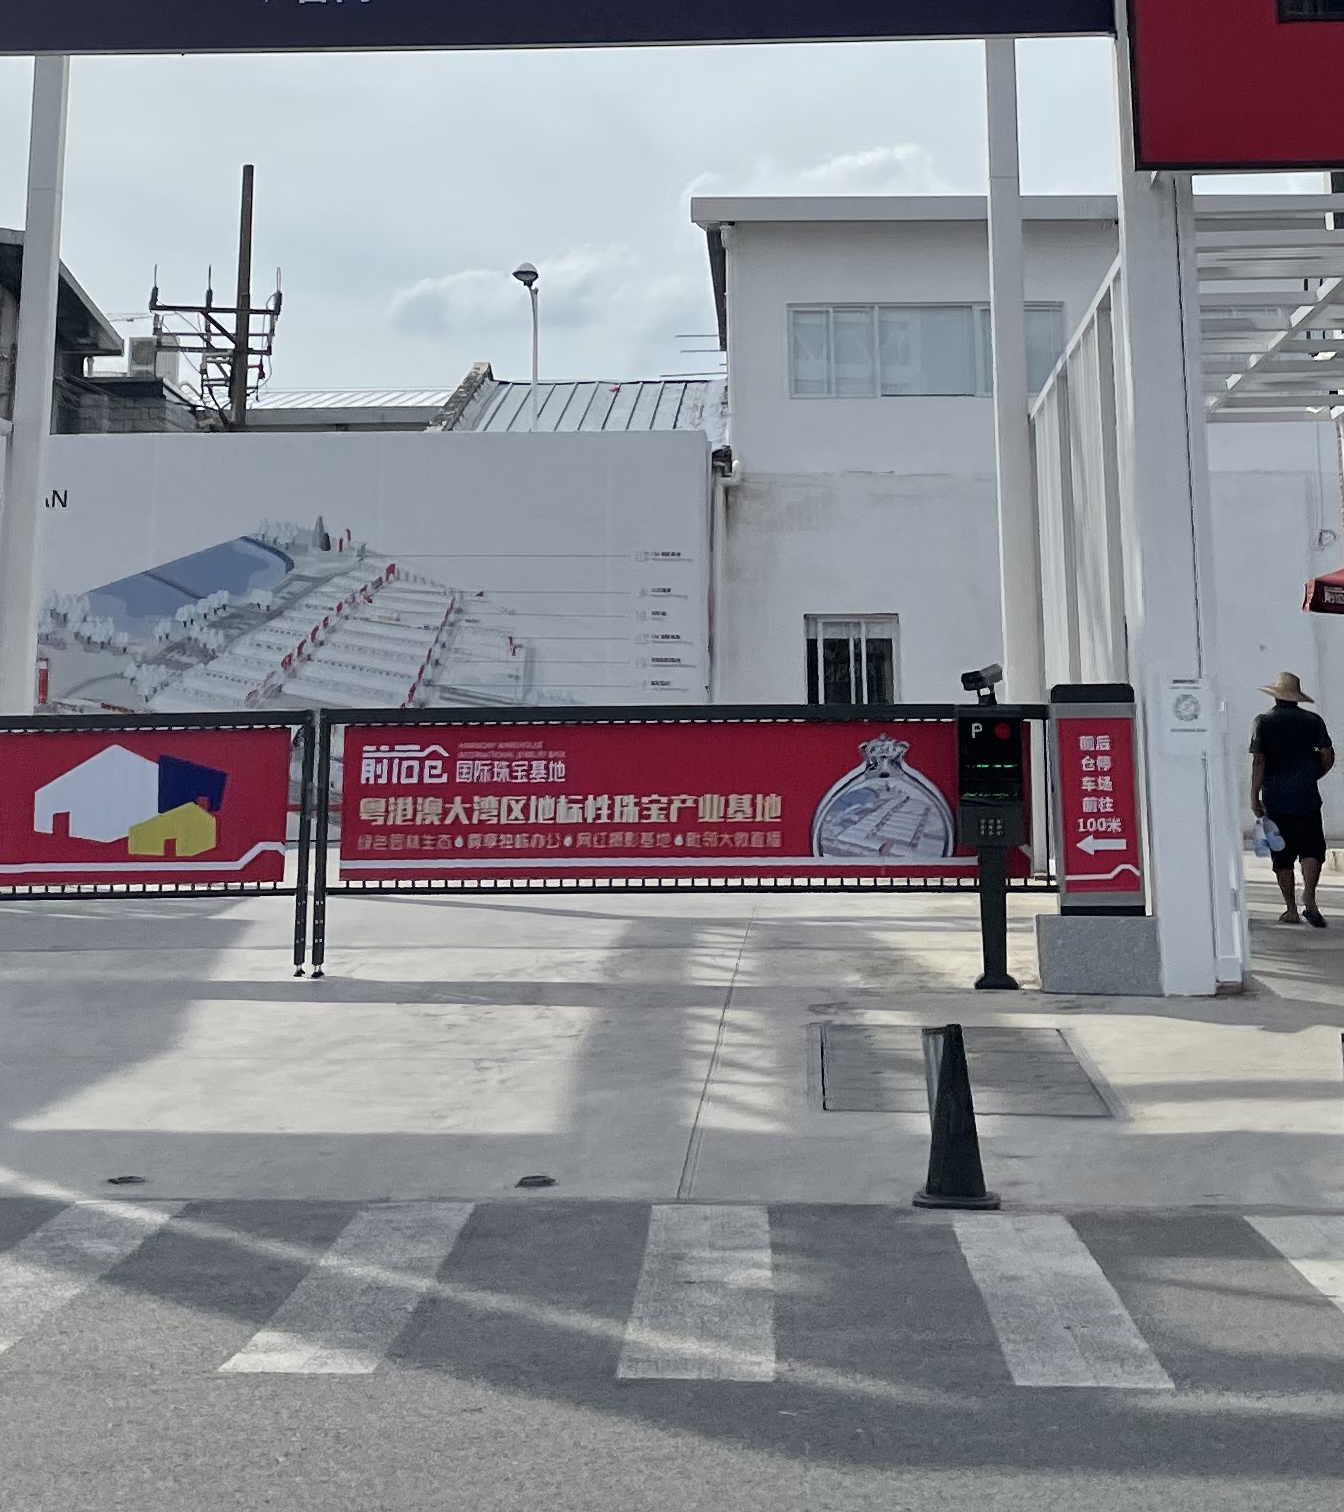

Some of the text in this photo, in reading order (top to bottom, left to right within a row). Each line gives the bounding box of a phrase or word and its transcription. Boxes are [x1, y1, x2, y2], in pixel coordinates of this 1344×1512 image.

[359, 794, 783, 825] 粤港澳大湾区地标性珠宝产业基地
